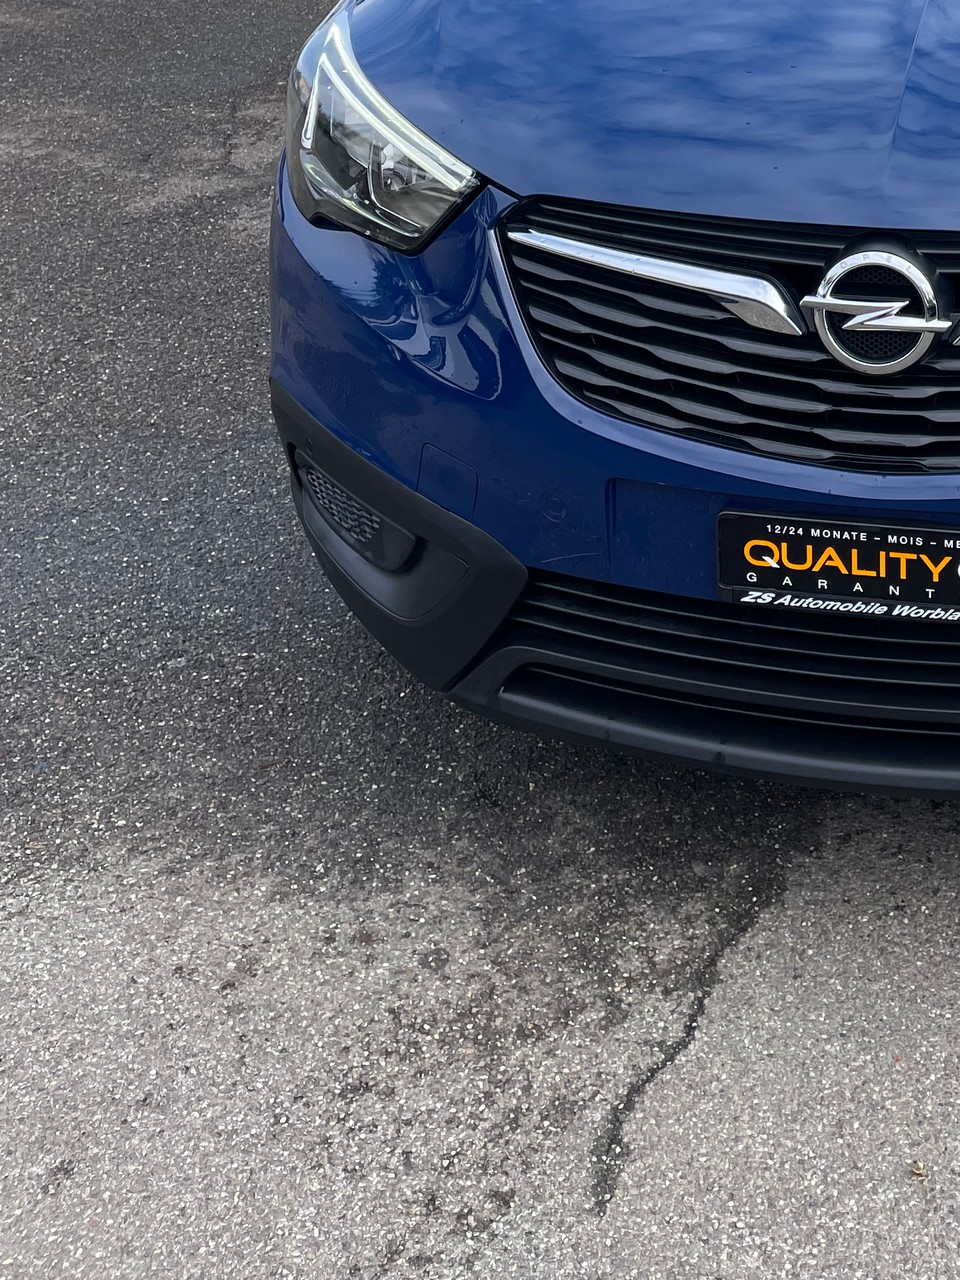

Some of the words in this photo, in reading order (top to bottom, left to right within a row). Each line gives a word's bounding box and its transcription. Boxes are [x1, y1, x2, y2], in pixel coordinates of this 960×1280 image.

[839, 253, 912, 274] OPEL
[766, 524, 804, 536] 12/24
[810, 528, 868, 542] MONATE
[887, 534, 923, 546] MOIS
[743, 539, 953, 582] QUALITY
[740, 591, 775, 604] ZS
[773, 594, 888, 615] Automobile
